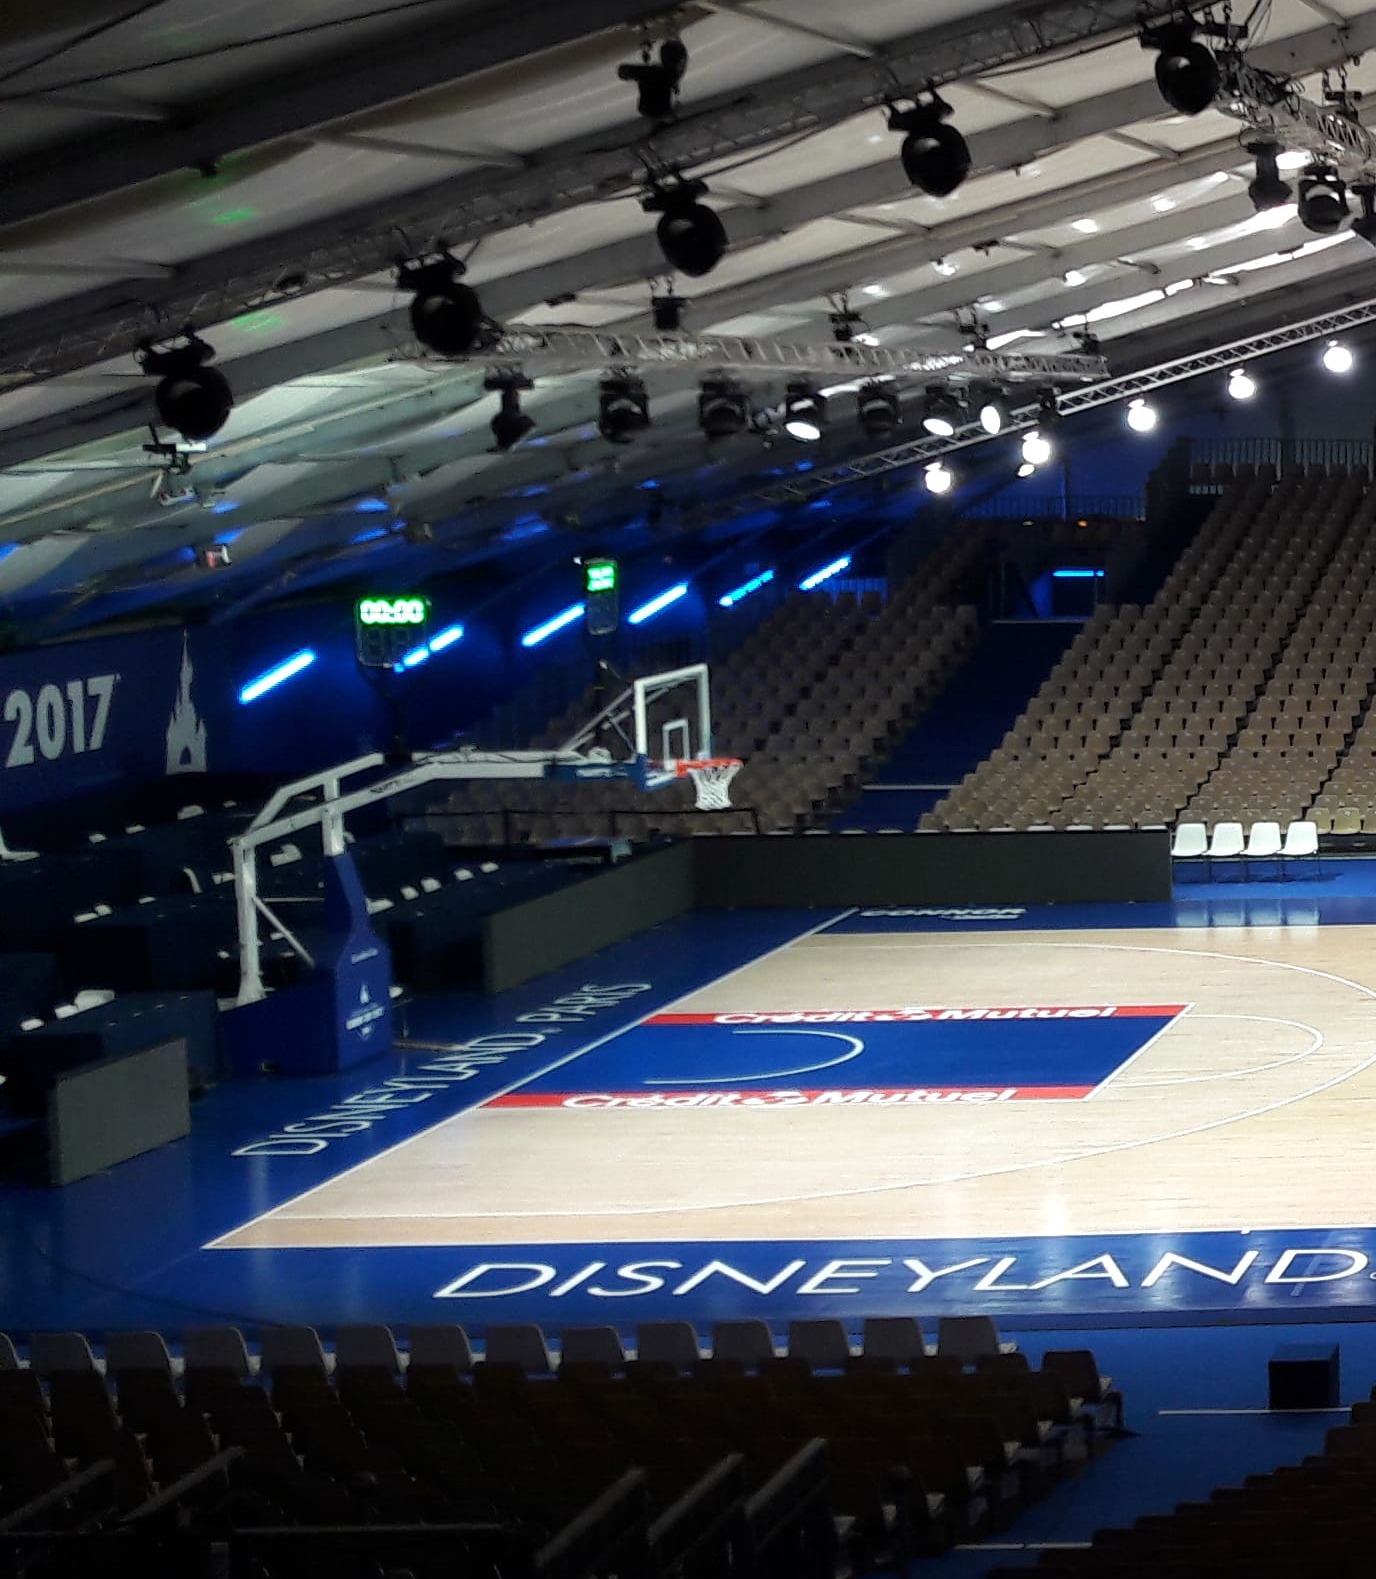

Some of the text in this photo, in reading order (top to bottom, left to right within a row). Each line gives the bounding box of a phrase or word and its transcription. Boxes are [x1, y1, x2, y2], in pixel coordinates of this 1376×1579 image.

[4, 673, 121, 768] 2017
[516, 983, 652, 1023] PARIS
[937, 1004, 1117, 1020] Mutuel
[810, 1087, 1018, 1105] Mutuel
